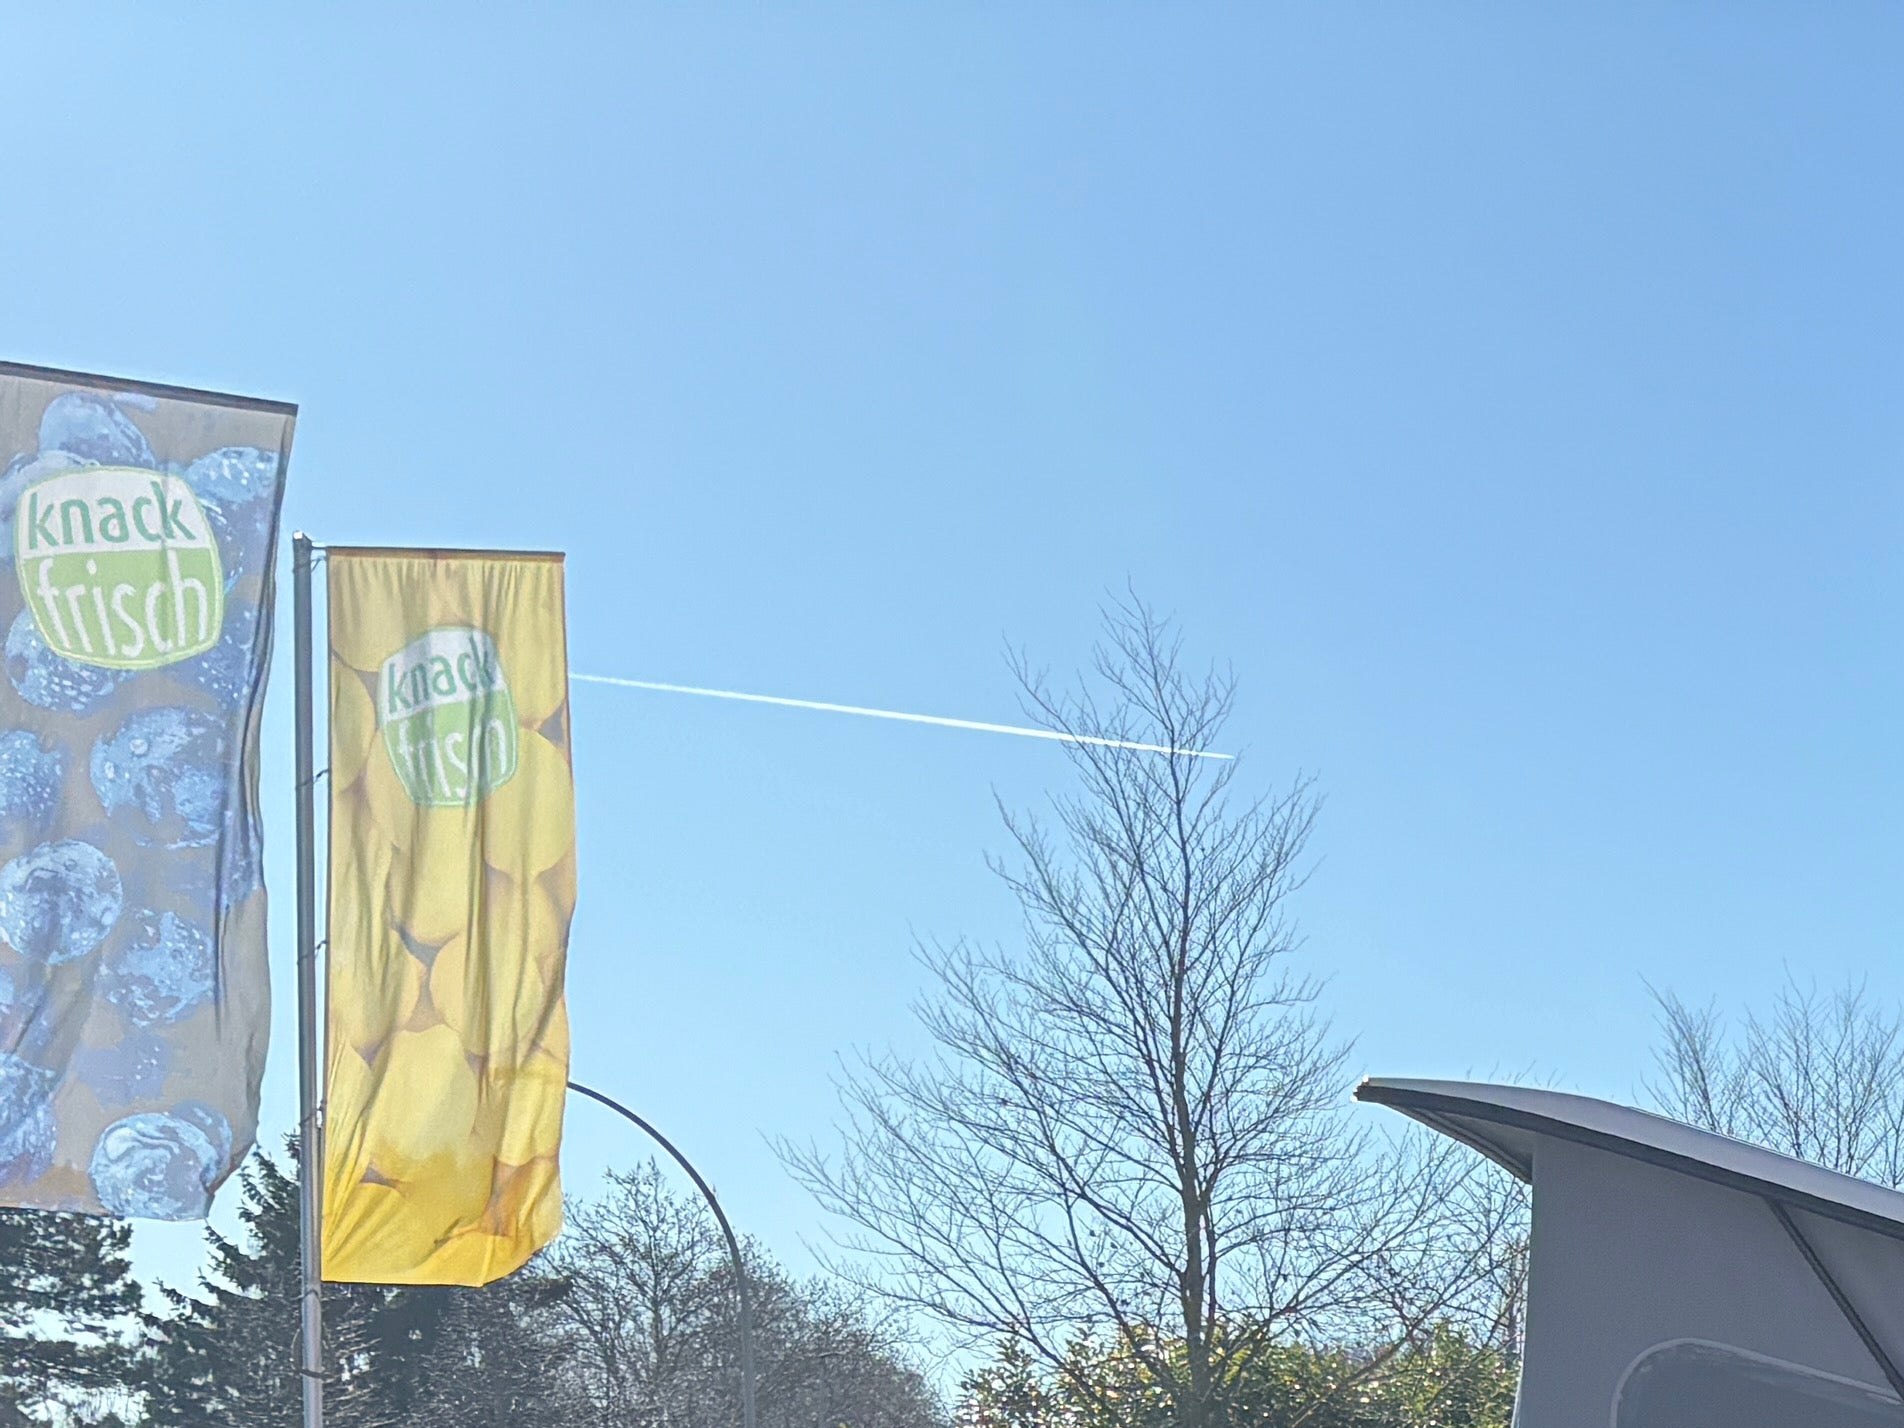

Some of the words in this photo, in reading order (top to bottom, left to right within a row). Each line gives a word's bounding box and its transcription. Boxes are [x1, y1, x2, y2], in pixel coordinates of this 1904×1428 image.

[28, 480, 196, 550] knack
[37, 549, 208, 657] frisch
[387, 635, 495, 715] knack
